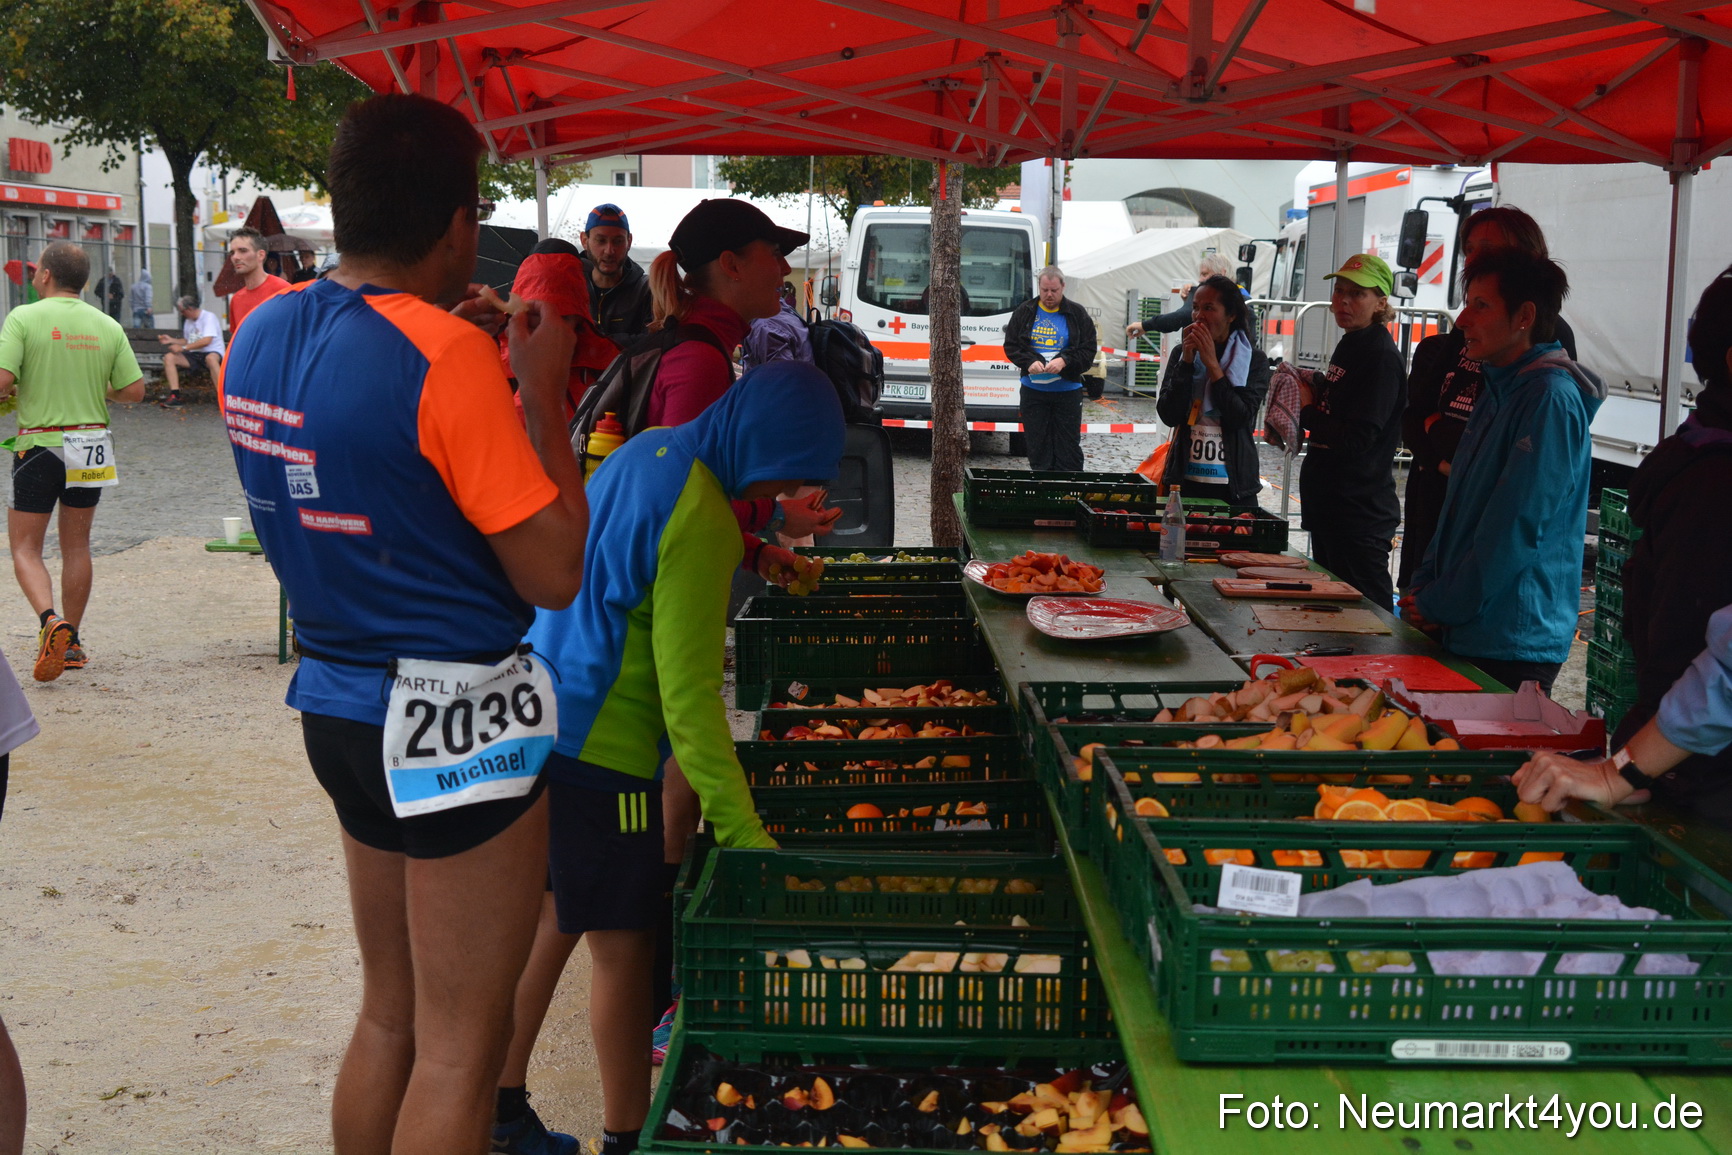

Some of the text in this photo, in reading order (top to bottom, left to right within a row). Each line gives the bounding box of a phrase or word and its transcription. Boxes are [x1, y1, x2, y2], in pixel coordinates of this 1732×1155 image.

[9, 138, 52, 174] NKD
[911, 322, 930, 331] Baye
[961, 324, 977, 332] otes
[904, 386, 925, 396] 8010
[963, 385, 1015, 393] atastrophenschutz
[83, 444, 105, 467] 78
[1190, 439, 1225, 462] 908
[81, 471, 106, 481] Robert
[1187, 464, 1218, 476] Pranom
[289, 482, 314, 496] DAS
[396, 674, 450, 696] PARTL
[405, 682, 543, 759] 2036
[392, 757, 400, 767] B
[436, 746, 526, 791] Michael
